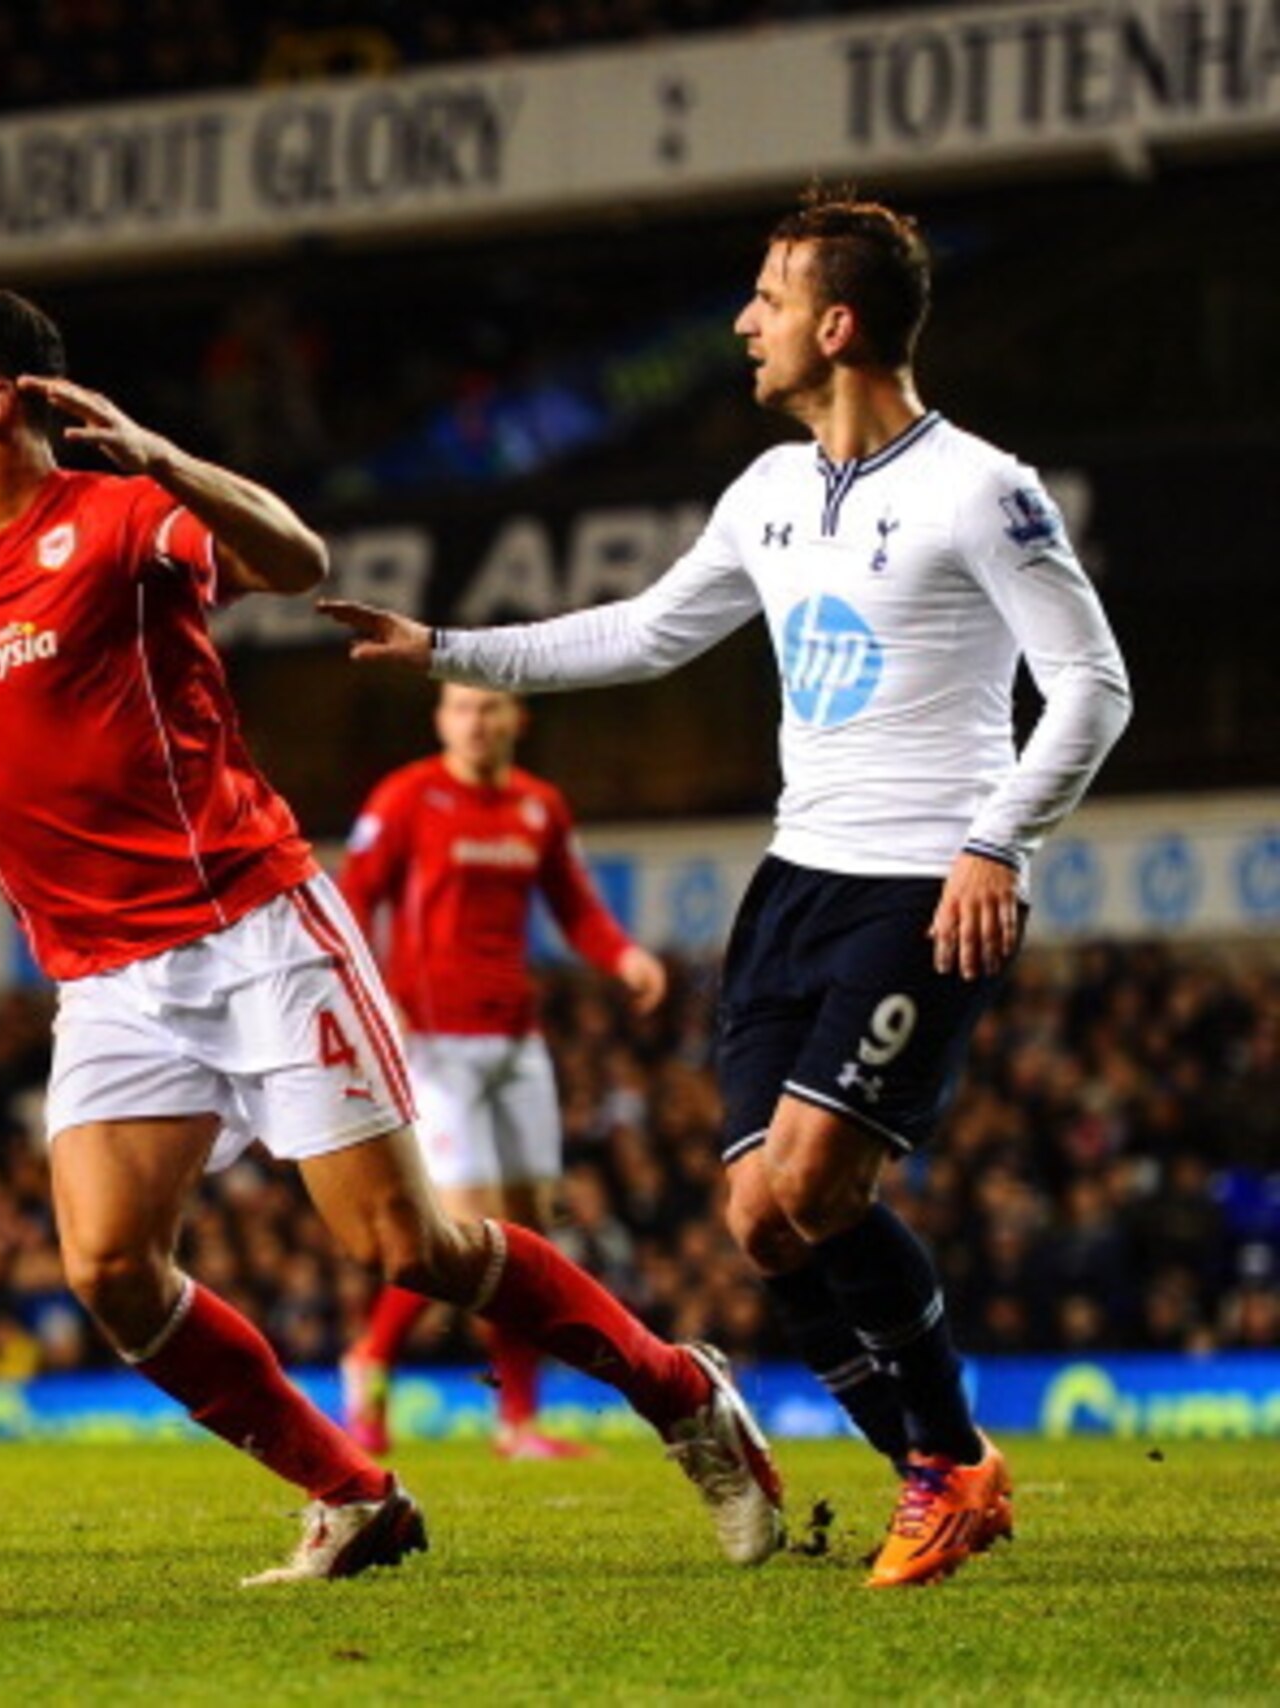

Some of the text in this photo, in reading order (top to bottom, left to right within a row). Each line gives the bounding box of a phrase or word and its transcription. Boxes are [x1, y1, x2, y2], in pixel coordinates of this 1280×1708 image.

[249, 80, 520, 210] GLORY
[787, 594, 874, 726] hp
[319, 1009, 363, 1078] 4
[858, 993, 917, 1066] 9
